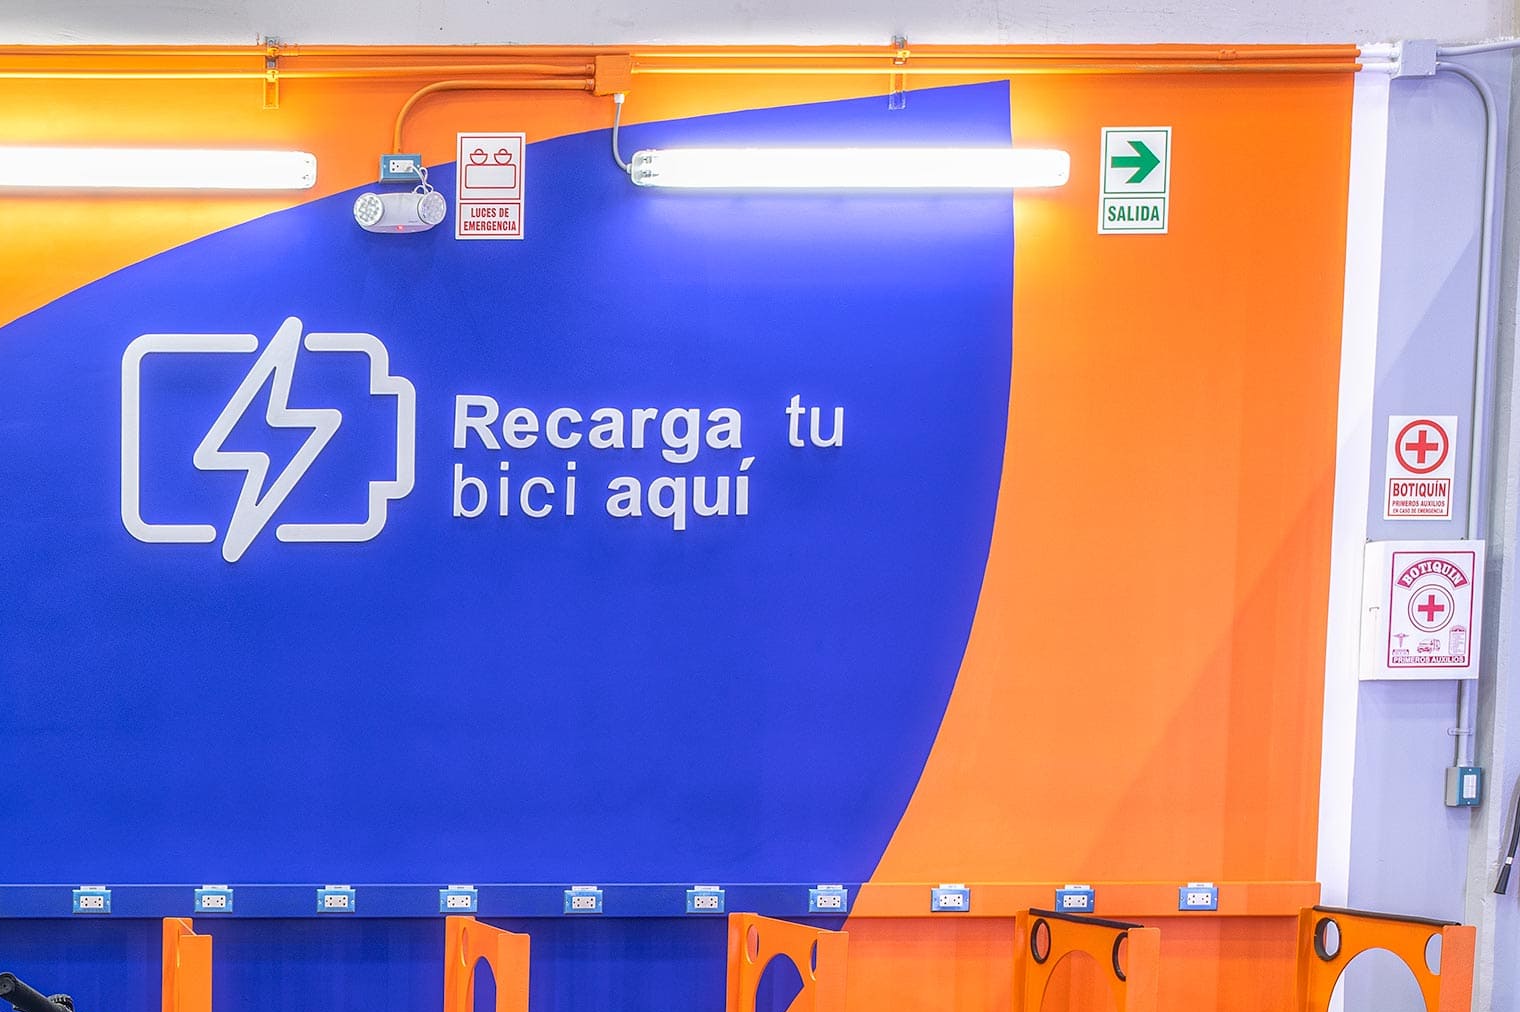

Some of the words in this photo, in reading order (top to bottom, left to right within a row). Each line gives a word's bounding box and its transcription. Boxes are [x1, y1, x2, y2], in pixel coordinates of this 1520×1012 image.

[471, 207, 496, 218] LUCES
[499, 207, 509, 218] DE
[1108, 205, 1160, 222] SALIDA
[463, 221, 516, 231] EMERGENCIA
[453, 394, 742, 464] Recarga
[785, 394, 844, 449] tu
[452, 461, 576, 519] bici
[606, 456, 755, 531] aquí
[1393, 480, 1446, 497] BOTIQUÍN
[1401, 561, 1463, 586] BOTIQUIN
[1393, 655, 1430, 663] PRIMEROS
[1430, 655, 1465, 663] AUXILIOS
